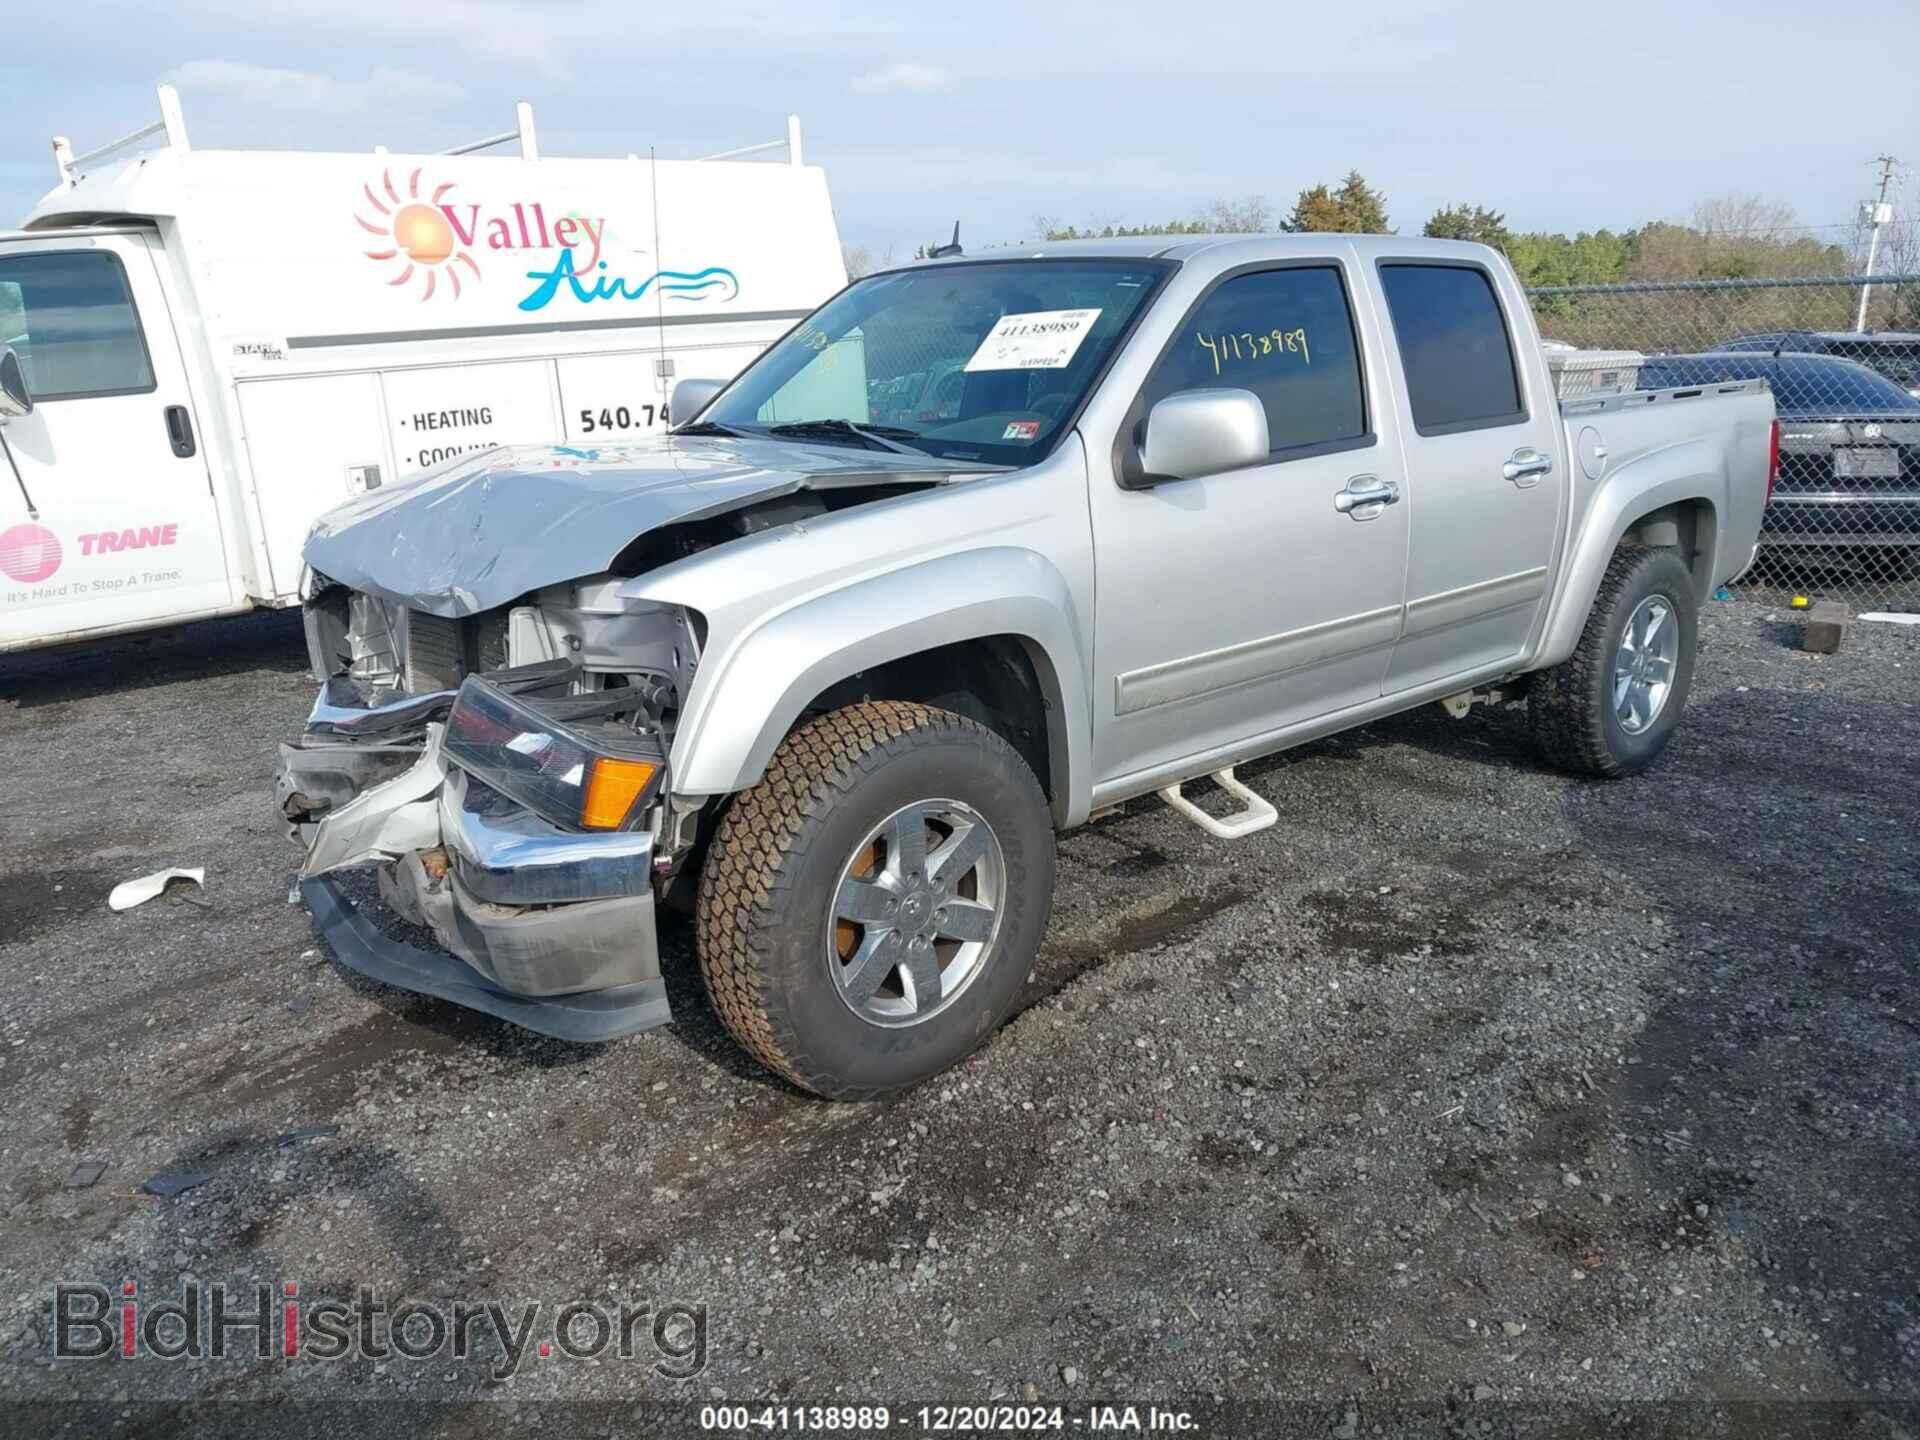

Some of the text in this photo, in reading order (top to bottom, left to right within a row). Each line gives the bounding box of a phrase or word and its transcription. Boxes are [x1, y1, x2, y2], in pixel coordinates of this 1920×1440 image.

[437, 202, 606, 277] Valley
[518, 248, 655, 311] Air
[998, 320, 1080, 337] 41138989
[1197, 328, 1310, 375] 41138989
[412, 407, 493, 432] HEATING
[581, 402, 670, 433] 540.74
[78, 523, 178, 556] TRANE
[7, 591, 28, 603] It's
[32, 585, 68, 600] Hard
[72, 582, 88, 594] To
[92, 578, 124, 592] Stop
[127, 575, 138, 586] A
